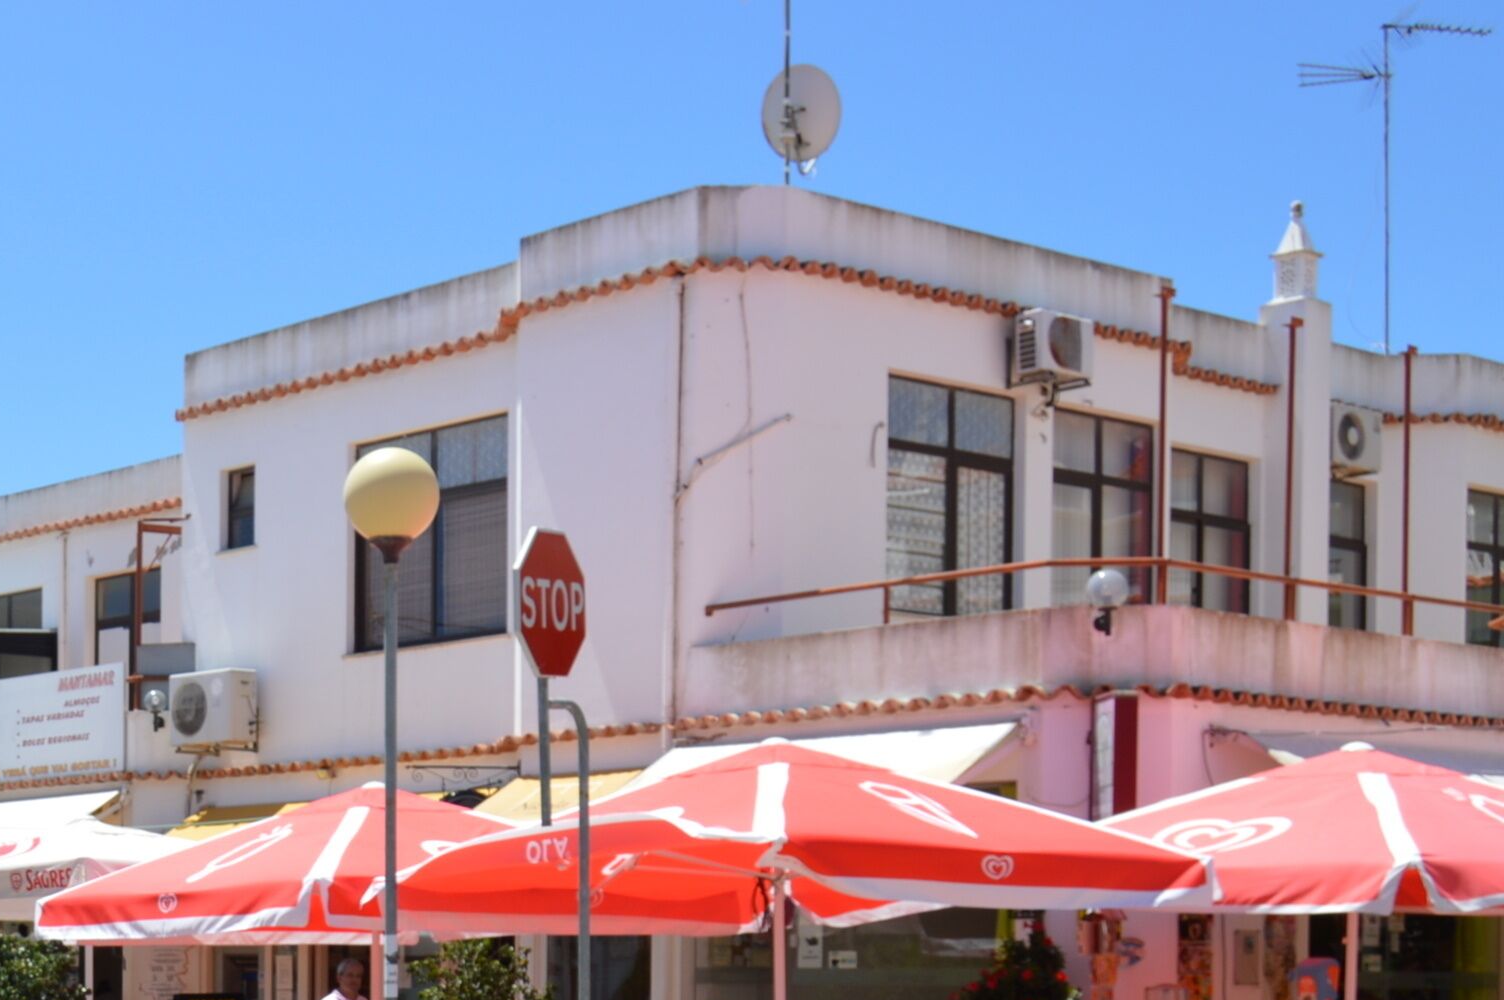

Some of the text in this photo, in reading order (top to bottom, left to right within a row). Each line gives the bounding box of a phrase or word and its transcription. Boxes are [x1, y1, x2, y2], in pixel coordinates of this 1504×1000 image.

[522, 575, 584, 632] STOP
[58, 669, 115, 692] MANTAMAR
[22, 710, 85, 724] TAPAS VARIADAS
[22, 732, 90, 747] BOLOS REGIONAIS
[25, 868, 72, 891] SAGRES
